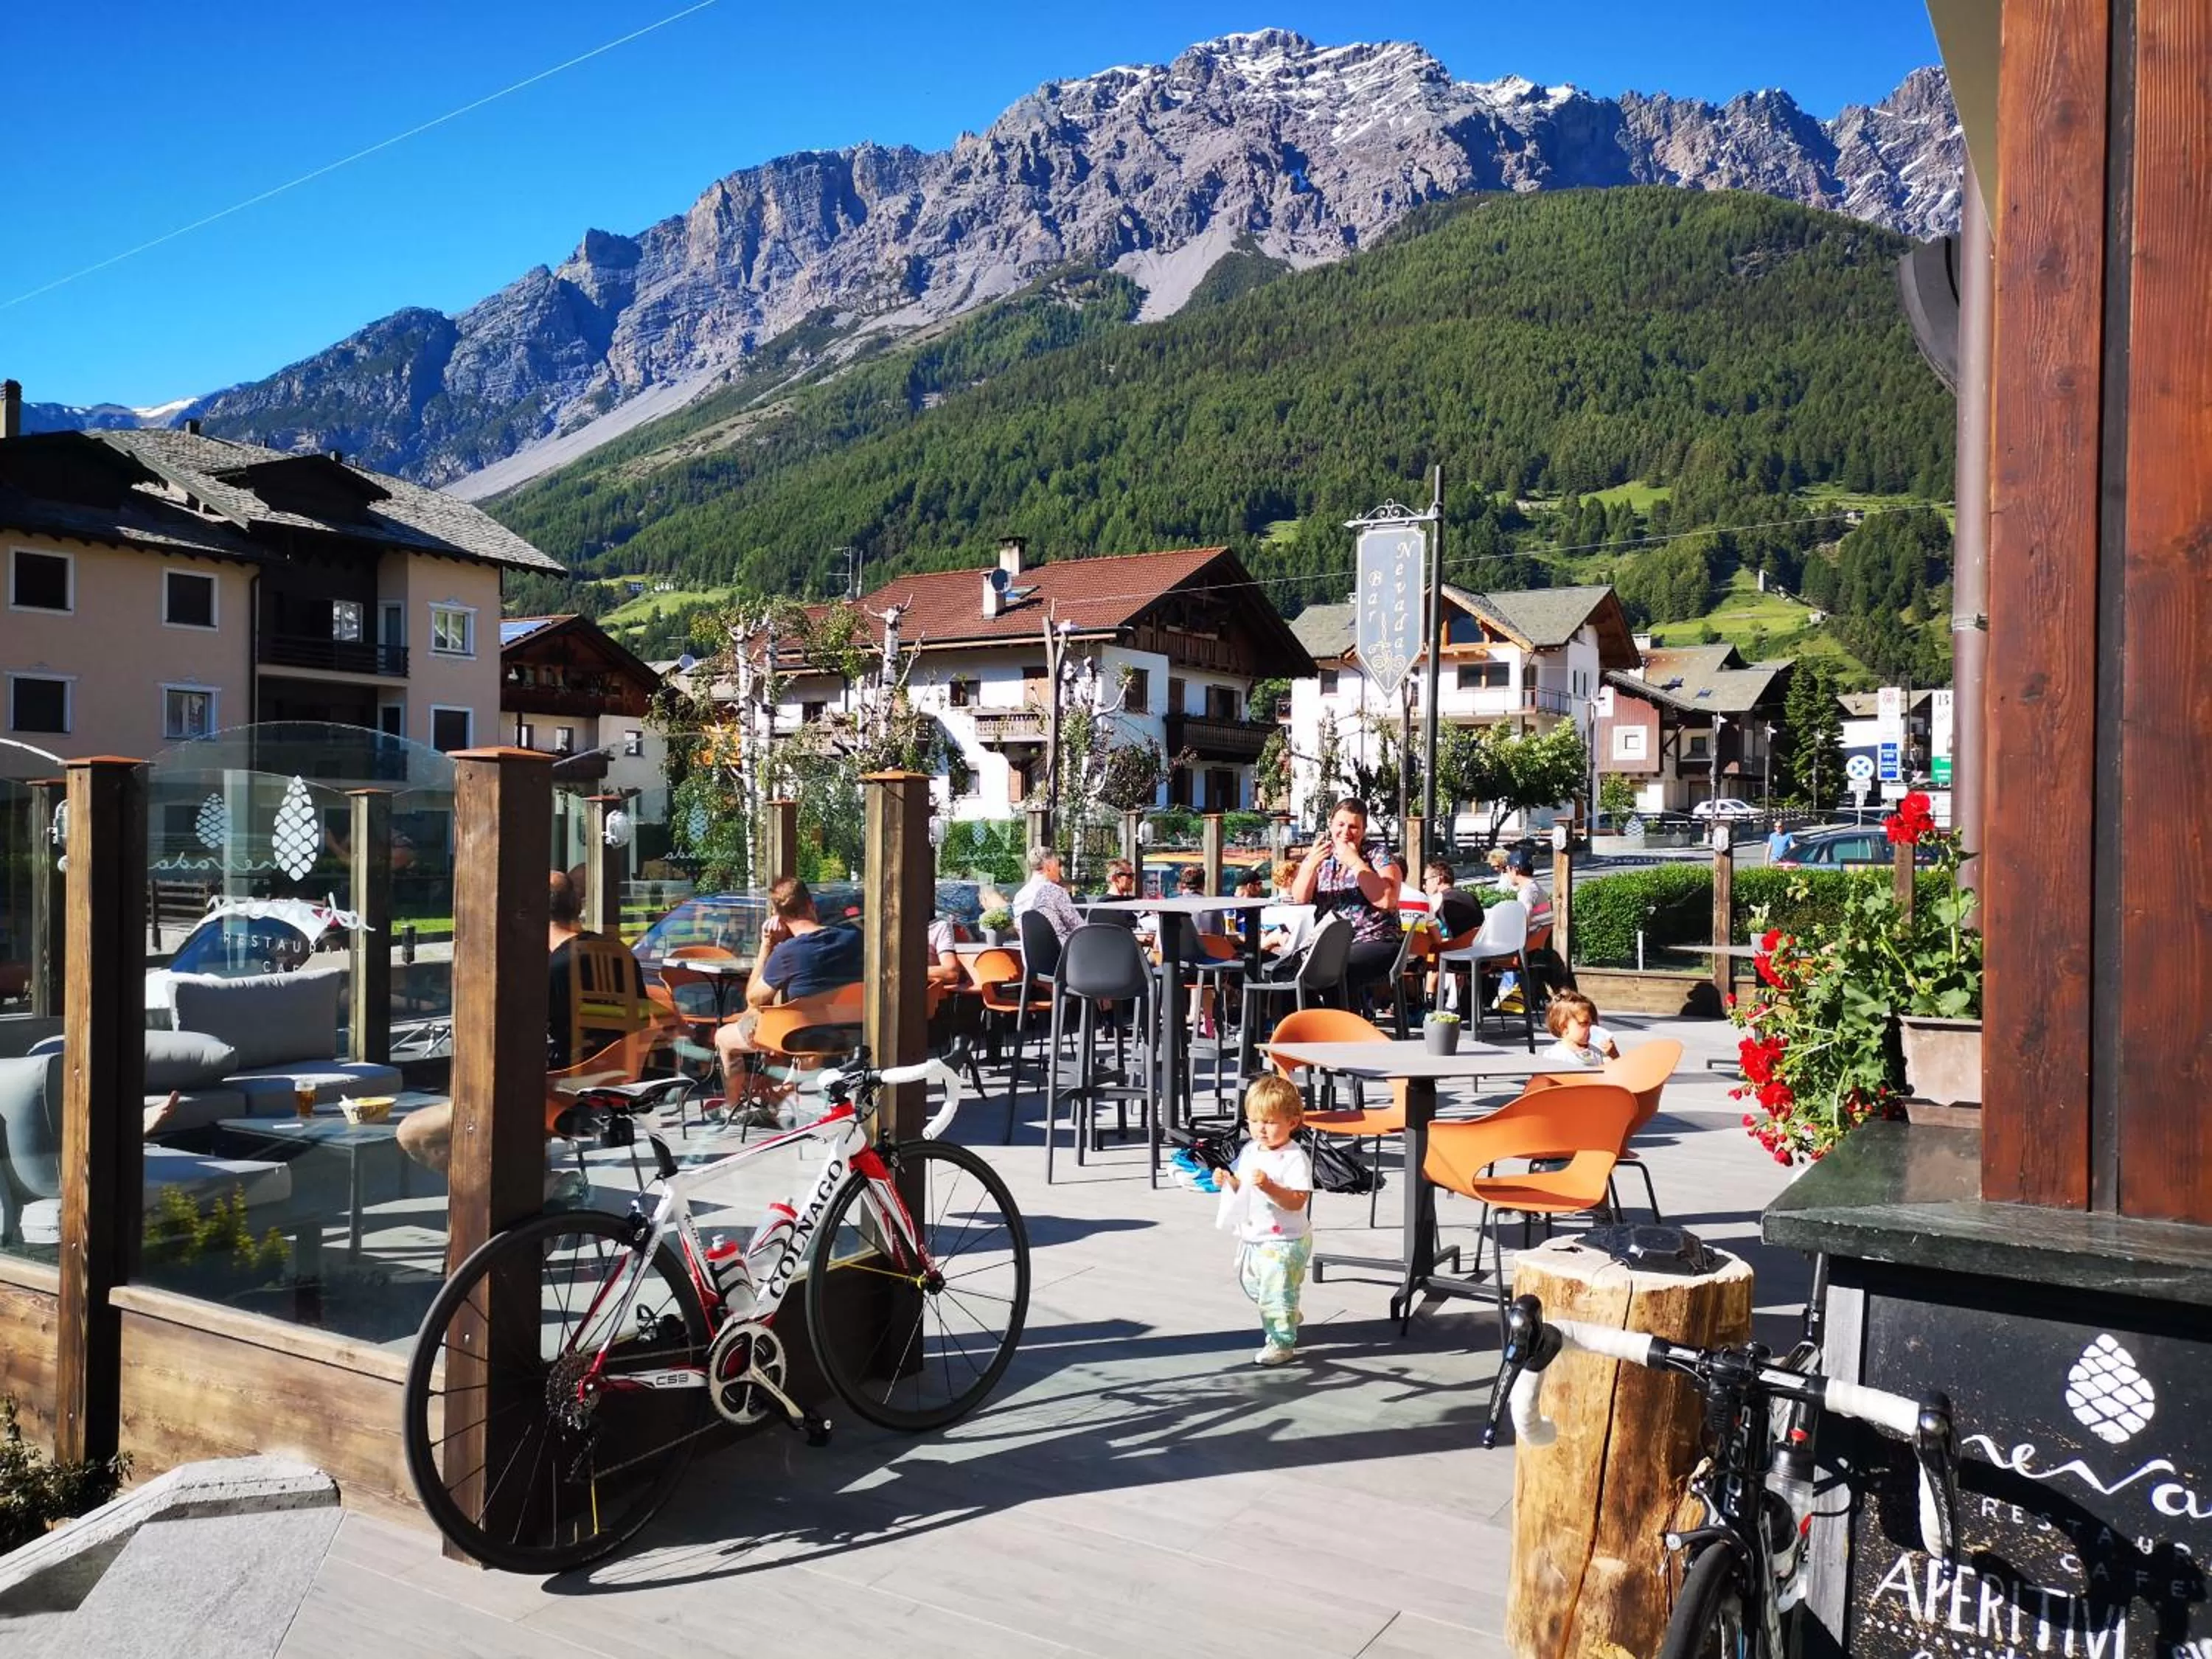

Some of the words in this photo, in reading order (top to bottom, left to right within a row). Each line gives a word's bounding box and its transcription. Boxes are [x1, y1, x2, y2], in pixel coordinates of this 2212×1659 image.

[1368, 570, 1382, 623] Bar
[1395, 542, 1416, 650] Nevada
[770, 1160, 843, 1298] COLNAGO
